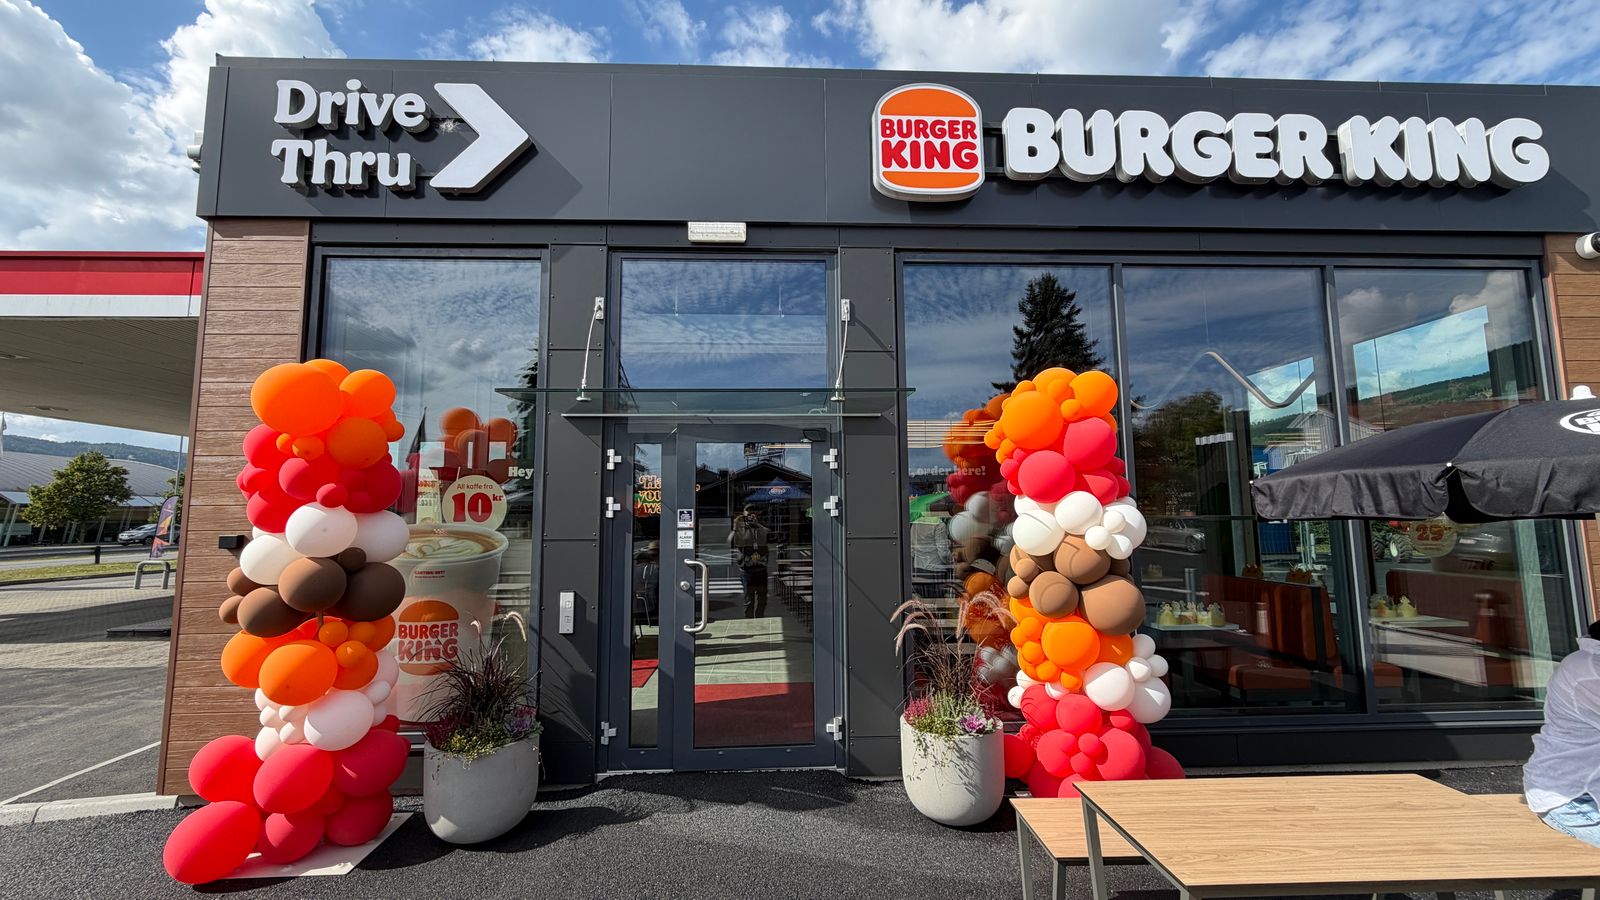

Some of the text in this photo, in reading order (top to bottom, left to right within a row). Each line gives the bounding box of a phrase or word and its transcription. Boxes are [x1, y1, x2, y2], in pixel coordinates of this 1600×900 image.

[272, 78, 429, 130] Drive
[880, 118, 977, 140] BURGER
[881, 139, 979, 170] KING
[1003, 107, 1550, 185] BURGER KING
[270, 137, 415, 189] Thru
[508, 466, 534, 480] Hey
[916, 465, 951, 476] order
[953, 465, 986, 476] here!
[451, 492, 493, 523] 10
[398, 622, 459, 640] BURGER
[398, 638, 459, 662] KING
